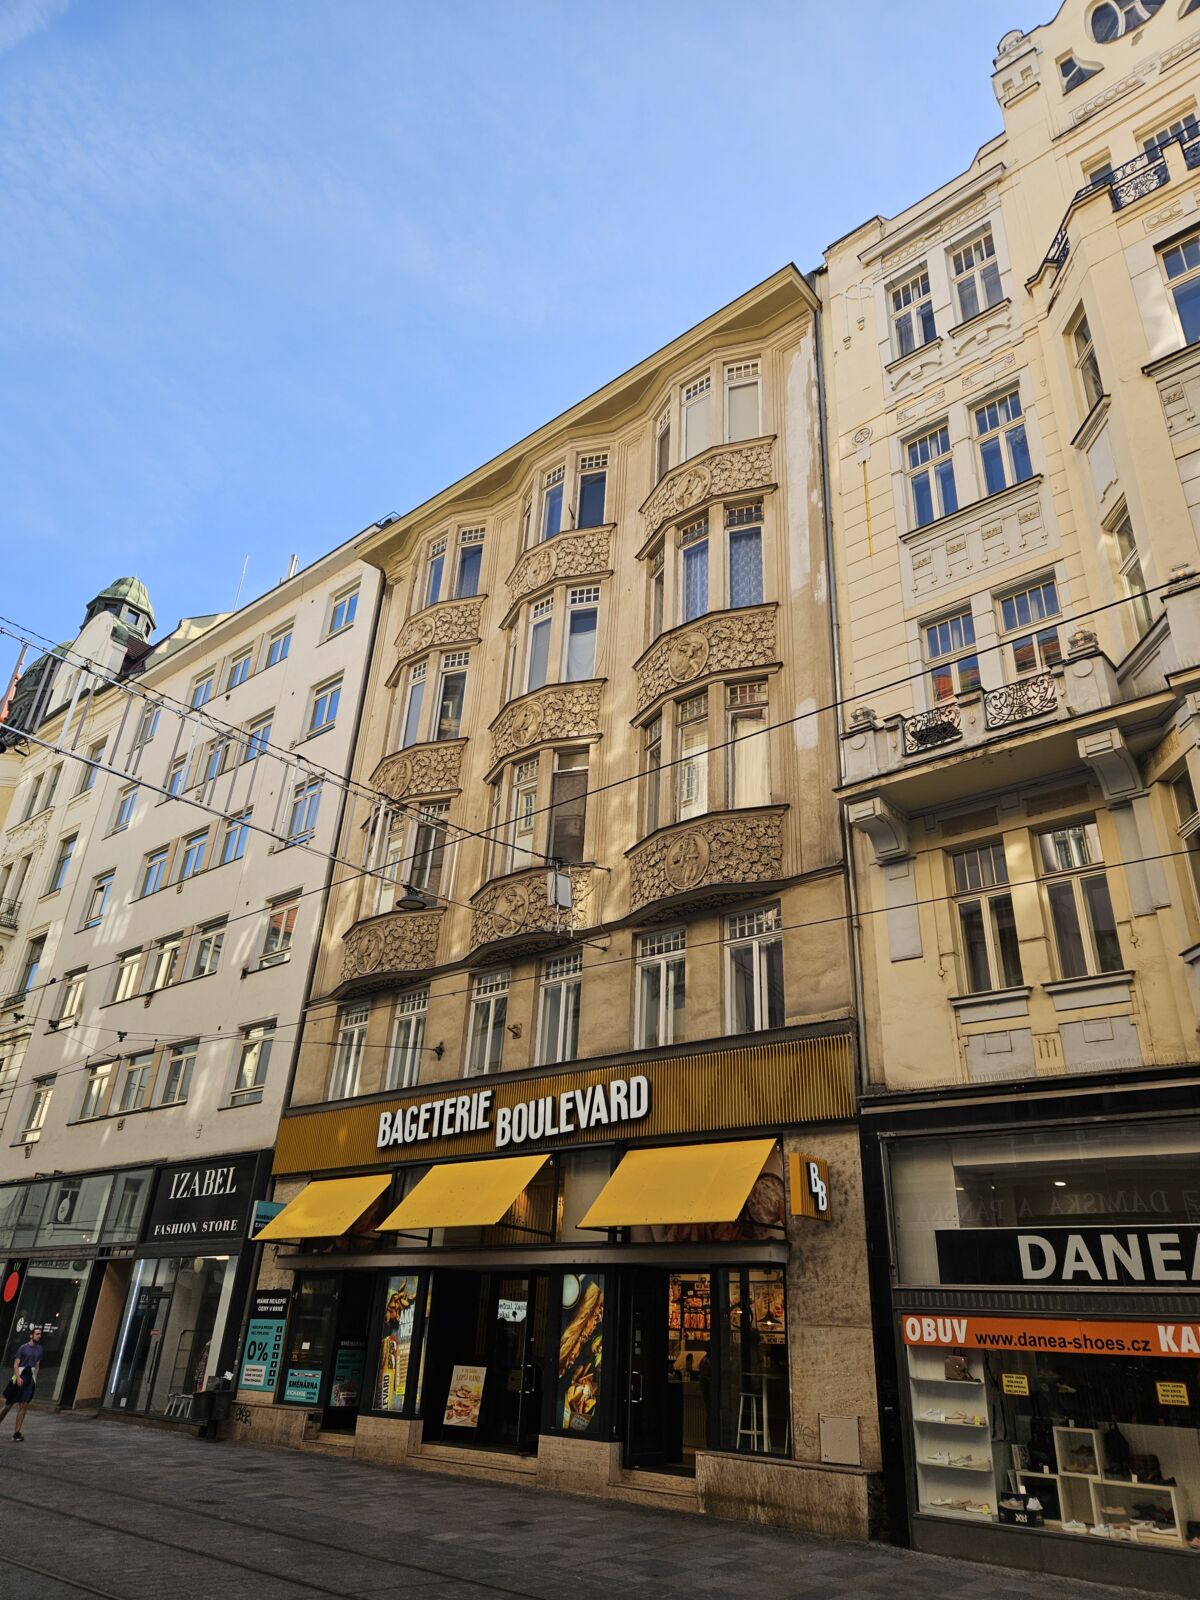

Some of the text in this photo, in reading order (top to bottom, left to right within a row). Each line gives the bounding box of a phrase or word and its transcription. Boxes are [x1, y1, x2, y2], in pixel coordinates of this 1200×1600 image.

[377, 1075, 649, 1148] BAGETERIE BOULEVARD
[168, 1166, 237, 1200] IZABEL
[153, 1219, 238, 1236] FASHION STORE
[1017, 1233, 1200, 1281] DANE
[247, 1340, 269, 1362] 0%
[905, 1317, 968, 1344] OBUV
[975, 1331, 1153, 1353] www.danea-shoes.cz
[287, 1378, 318, 1390] SMĚNÁRNA
